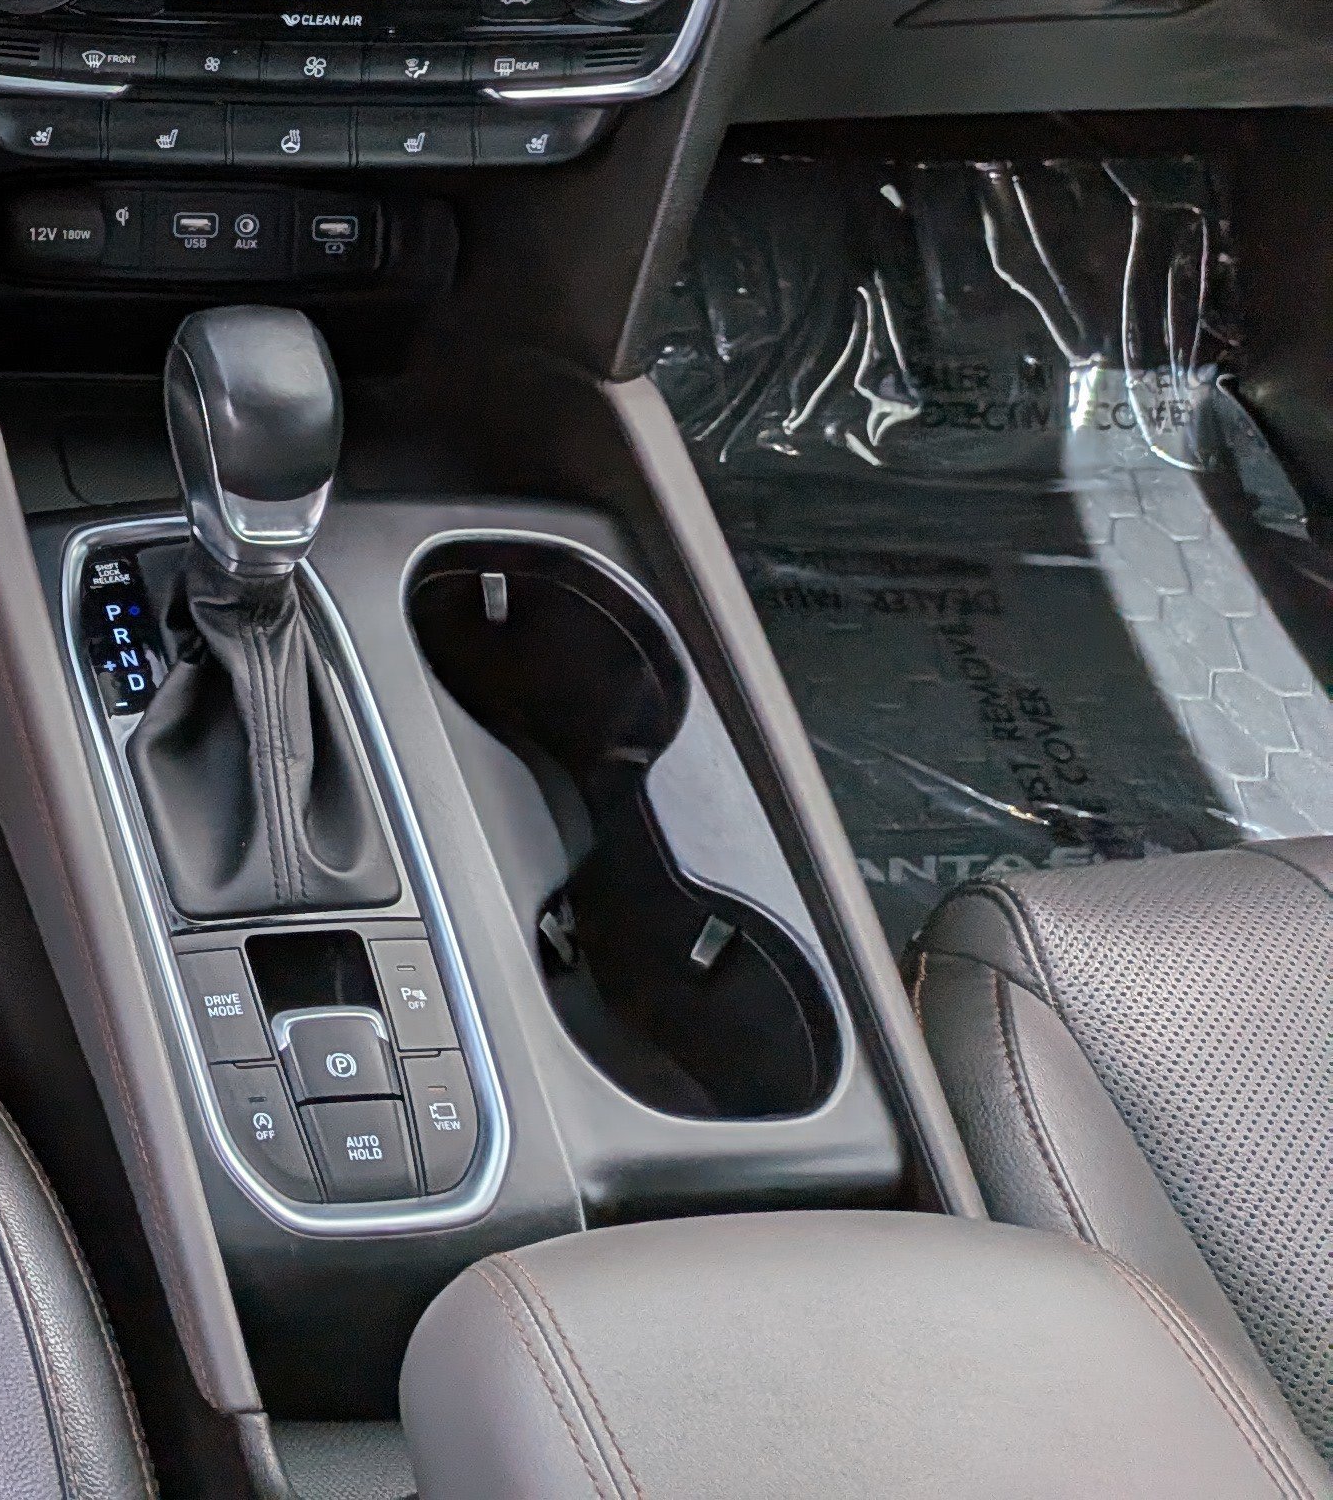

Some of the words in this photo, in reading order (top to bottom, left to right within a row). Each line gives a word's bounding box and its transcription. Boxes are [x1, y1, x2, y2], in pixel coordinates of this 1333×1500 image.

[301, 14, 338, 27] CLEAN
[339, 14, 363, 27] AIR
[107, 54, 137, 65] FRONT
[515, 61, 540, 72] REAR
[29, 227, 58, 241] 12V
[62, 229, 91, 240] 180W
[184, 238, 208, 249] USB
[234, 238, 258, 249] AUX
[98, 569, 121, 578] LOCK
[105, 604, 122, 622] P
[112, 627, 131, 645] R
[120, 650, 140, 668] N
[128, 673, 146, 691] D
[204, 992, 241, 1007] DRIVE
[407, 1000, 426, 1010] OFF
[208, 1003, 244, 1018] MODE
[433, 1120, 462, 1131] VIEW
[255, 1129, 276, 1141] OFF
[345, 1134, 380, 1148] AUTO
[348, 1147, 383, 1161] HOLD
